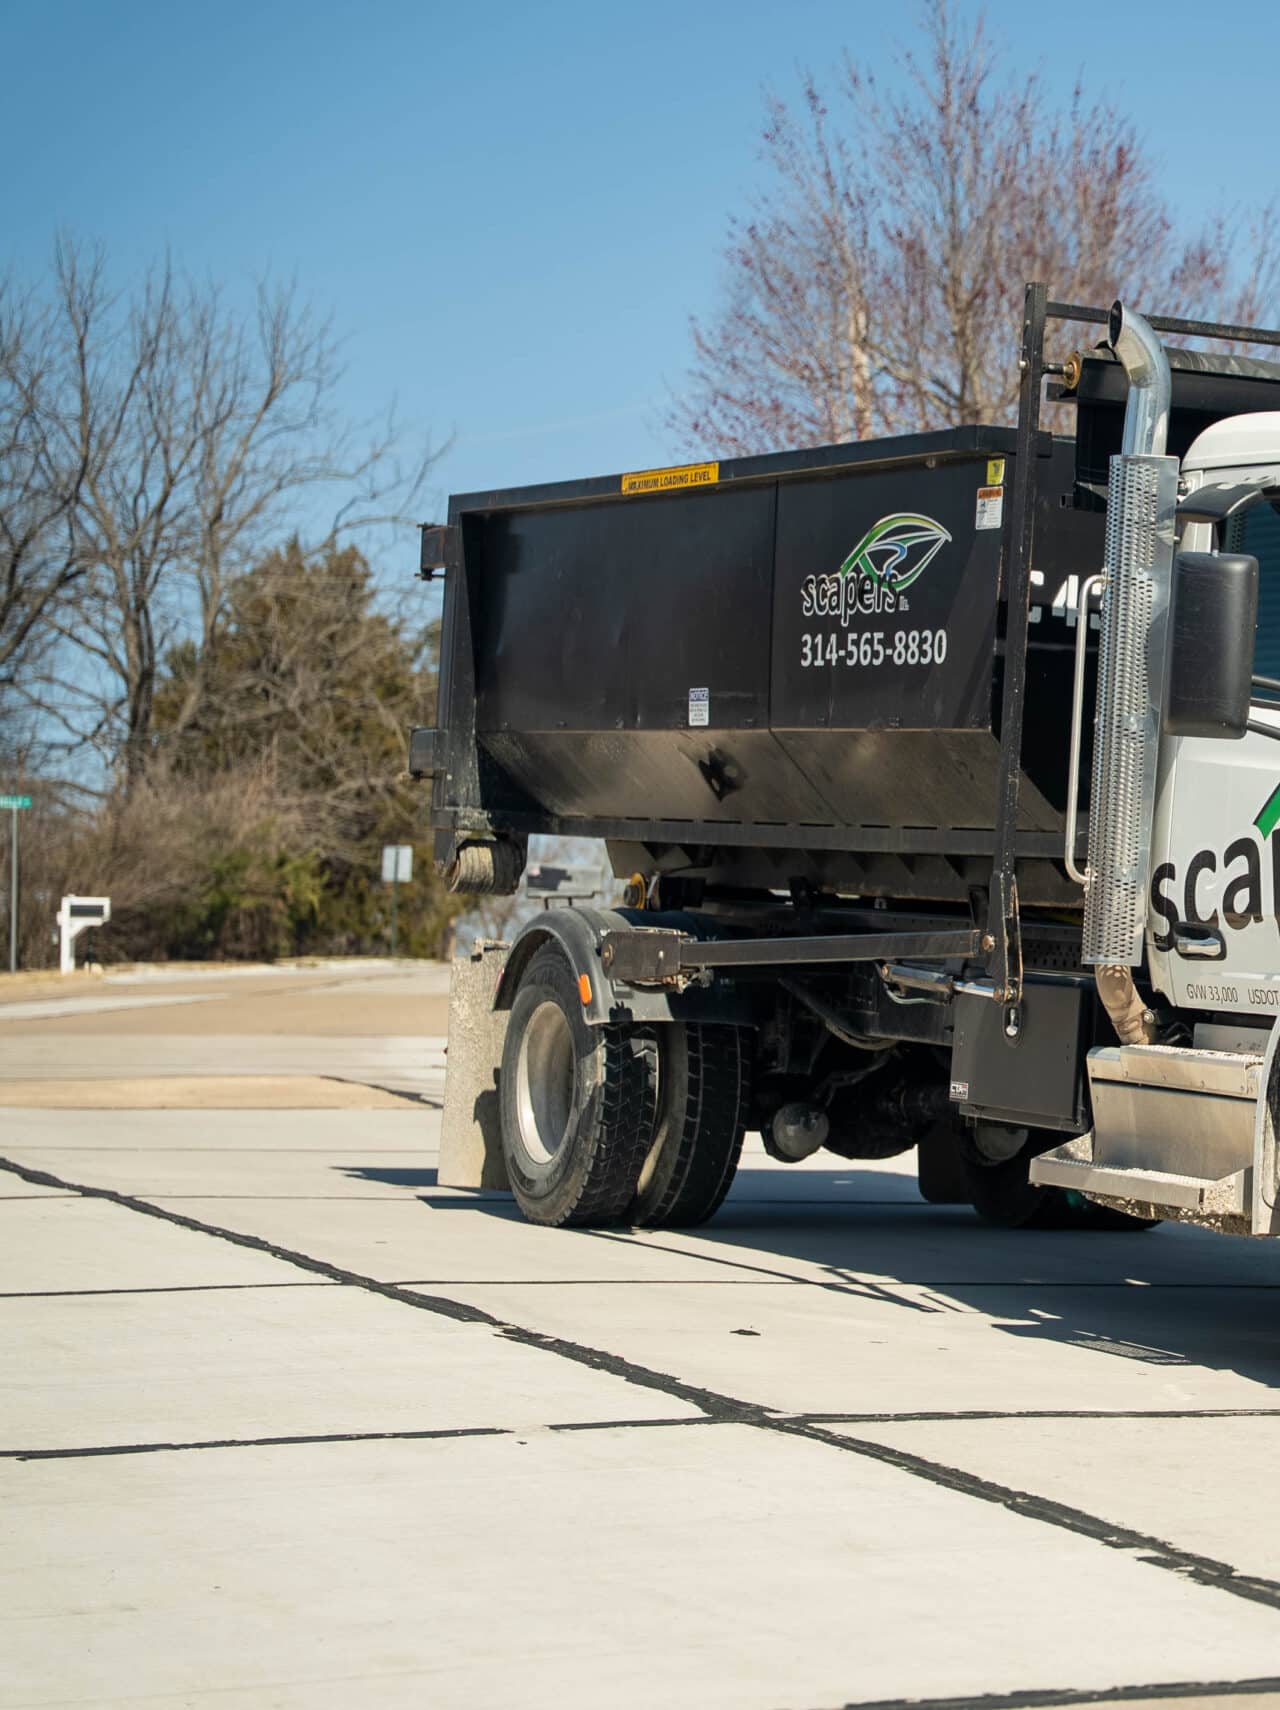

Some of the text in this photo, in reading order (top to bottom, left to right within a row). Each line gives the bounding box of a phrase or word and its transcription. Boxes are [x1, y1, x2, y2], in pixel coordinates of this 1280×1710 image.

[660, 473, 688, 487] LOADING
[690, 470, 711, 482] LEVEL
[801, 570, 899, 627] scapers
[801, 629, 947, 667] 314-565-8830
[1186, 983, 1207, 1000] GVW
[1208, 985, 1239, 1005] 33,000
[1247, 988, 1280, 1006] USDOT
